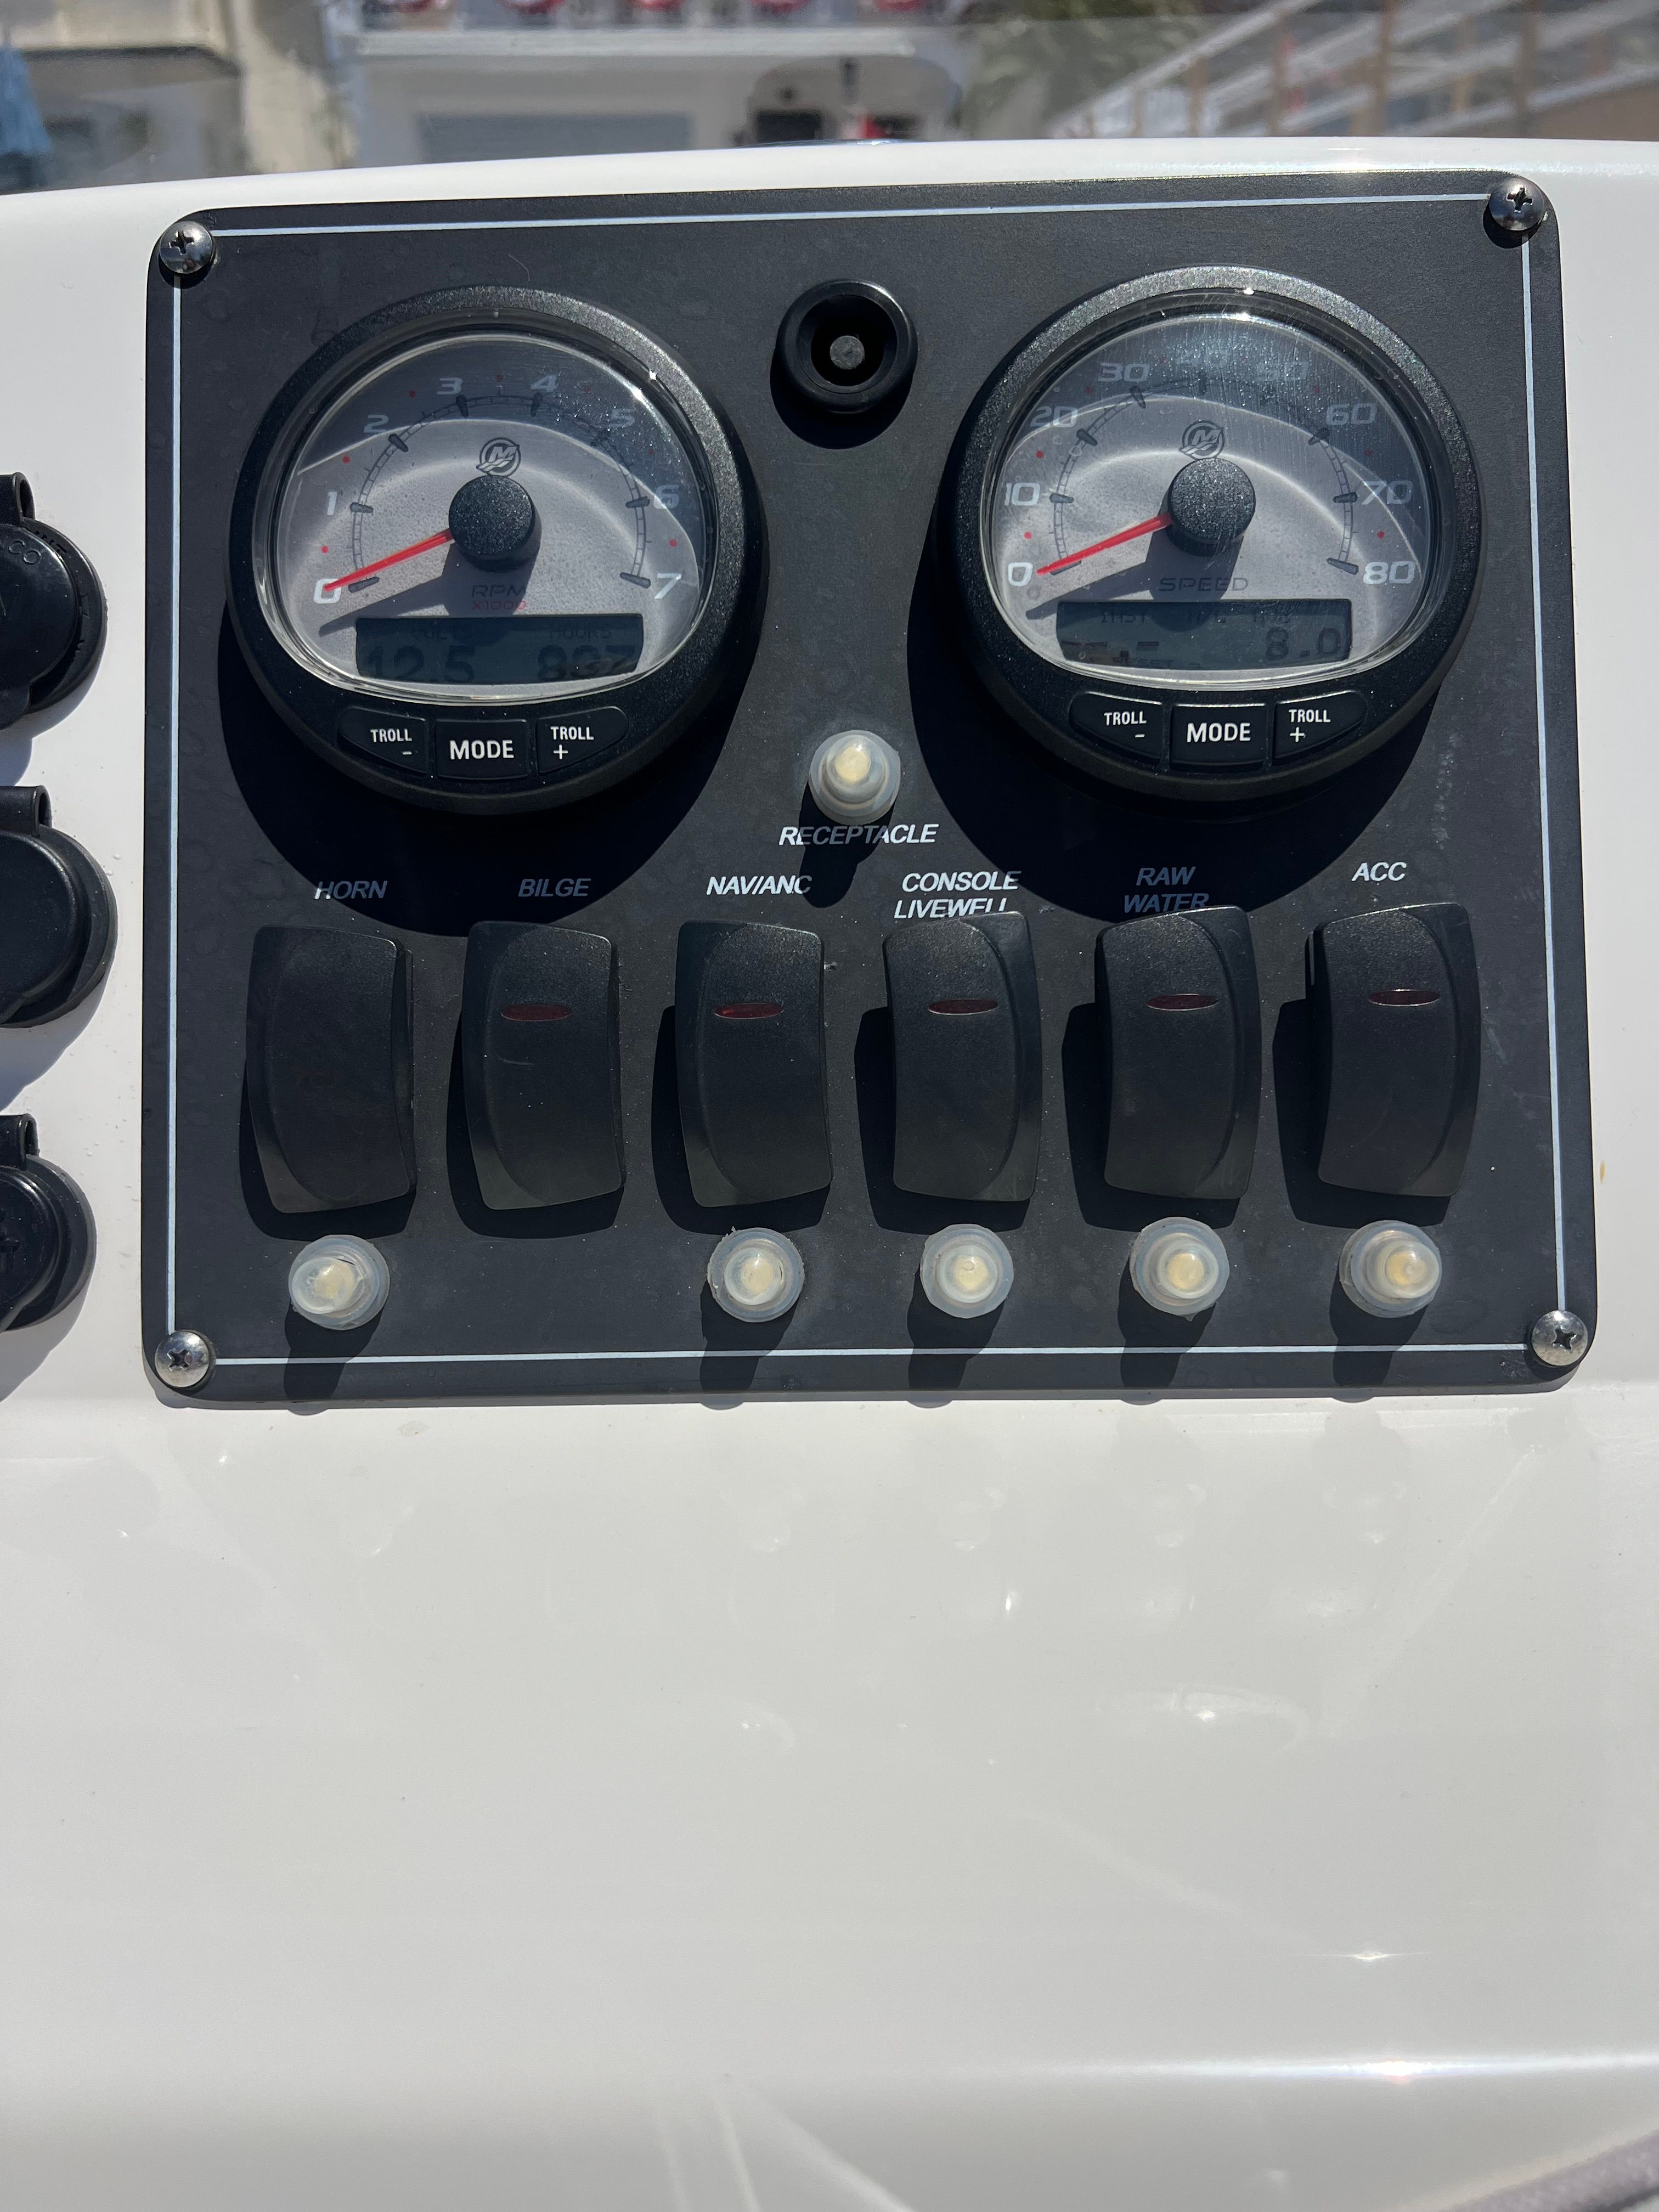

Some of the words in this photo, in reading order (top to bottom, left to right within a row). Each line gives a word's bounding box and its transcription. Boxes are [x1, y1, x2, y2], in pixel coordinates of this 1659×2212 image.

[1098, 362, 1150, 382] 30
[437, 377, 464, 396] 3
[530, 374, 558, 393] 4
[363, 414, 390, 433] 2
[607, 408, 635, 429] 5
[1030, 406, 1079, 428] 20
[1325, 403, 1375, 426] 60
[326, 491, 337, 516] 1
[653, 483, 680, 509] 6
[1005, 483, 1040, 506] 10
[1362, 481, 1413, 506] 70
[1007, 561, 1034, 586] 0
[1363, 561, 1416, 584] 80
[313, 578, 342, 604] 0
[471, 584, 527, 597] RPM
[654, 572, 682, 600] 7
[1159, 577, 1249, 592] SPEED
[1265, 627, 1341, 661] 8.0
[1103, 710, 1147, 726] TROLL
[1288, 708, 1331, 723] TROLL
[370, 727, 413, 743] TROLL
[550, 725, 595, 741] TROLL
[1186, 722, 1251, 743] MODE
[449, 739, 515, 760] MODE
[778, 823, 940, 846] RECEPTACLE
[901, 870, 1022, 893] CONSOLE
[1136, 866, 1197, 886] RAW
[1351, 861, 1408, 882] ACC
[313, 879, 388, 900] HORN
[518, 878, 592, 898] BILGE
[706, 874, 812, 895] NAV/ANC
[1124, 893, 1210, 914] WATER
